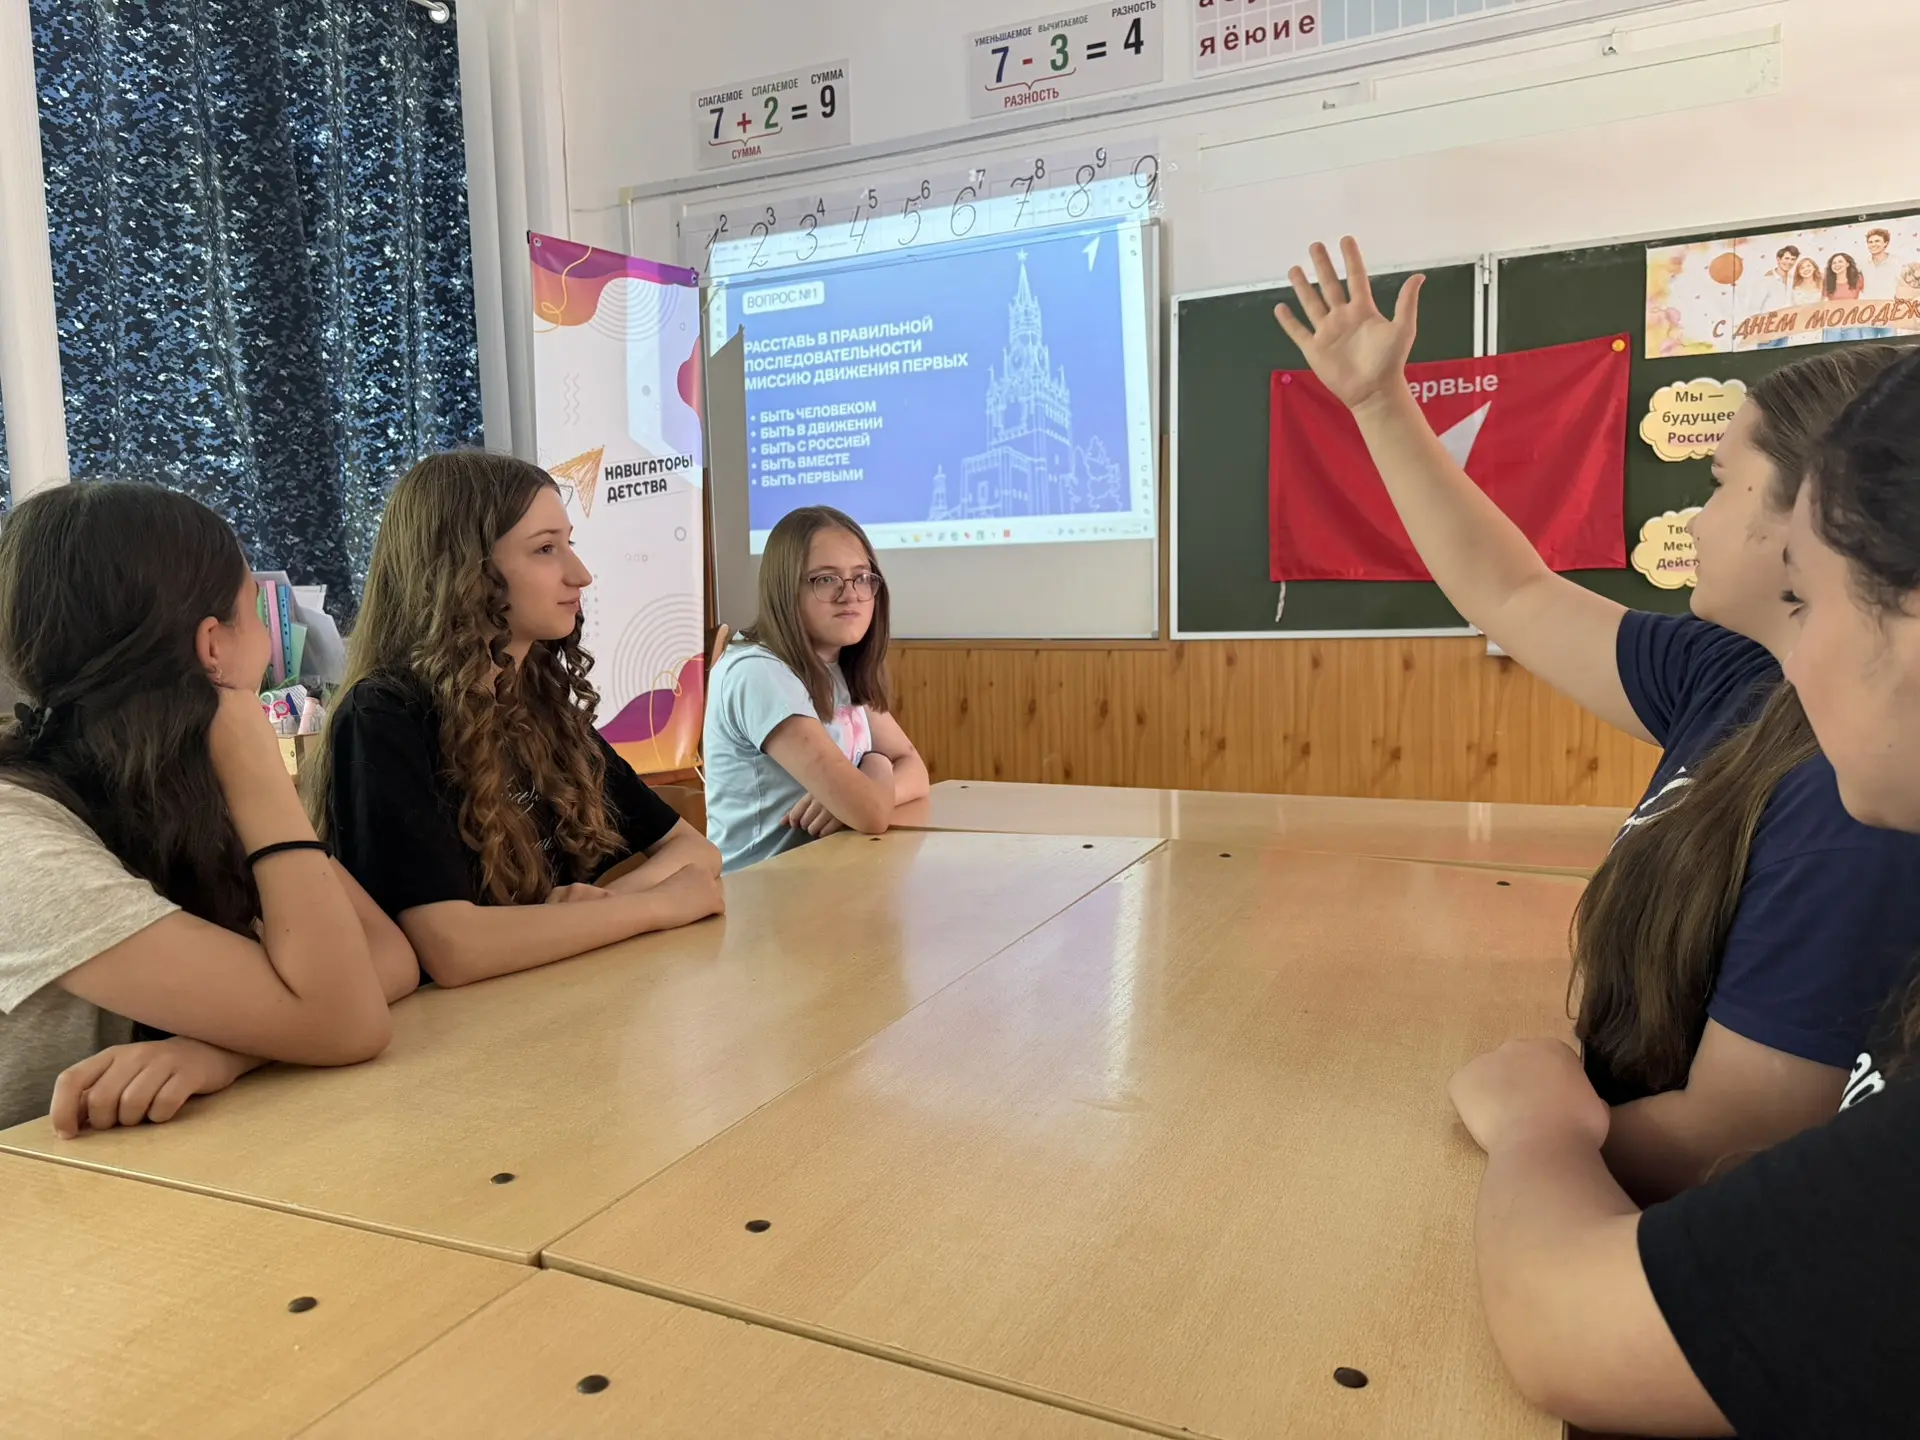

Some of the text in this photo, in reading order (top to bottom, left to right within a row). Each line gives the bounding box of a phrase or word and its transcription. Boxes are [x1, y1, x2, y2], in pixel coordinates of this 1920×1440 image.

[974, 1, 1157, 47] УМЕНЬШАЕМОЕ ВЫЧИТАЕМОЕ РАЗНОСТЬ
[991, 46, 1010, 84] 7
[1050, 33, 1069, 71] 3
[1123, 17, 1144, 56] 4
[698, 68, 844, 108] СЛАГАЕМОЕ СЛАГАЕМОЕ СУММА
[1004, 87, 1060, 109] РАЗНОСТЬ
[709, 106, 724, 139] 7
[763, 96, 779, 130] 2
[820, 84, 836, 119] 9
[731, 145, 762, 160] СУММА
[747, 289, 797, 309] ВОПРОС
[744, 315, 934, 355] РАССТАВЬ В ПРАВИЛЬНОЙ
[1712, 319, 1727, 338] С
[1732, 310, 1799, 341] ДНЁМ
[745, 339, 923, 373] ПОСЛЕДОВАТЕЛЬНОСТИ
[745, 352, 969, 391] МИССИЮ ДВИЖЕНИЯ ПЕРВЫХ
[1675, 391, 1703, 403] Мы
[760, 400, 877, 424] БЫТЬ ЧЕЛОВЕКОМ
[1662, 410, 1735, 427] будущее
[760, 416, 883, 439] БЫТЬ В ДВИЖЕНИИ
[760, 432, 871, 455] БЫТЬ С РОССИЕЙ
[604, 454, 693, 481] НАВИГАТОРЫ
[761, 453, 851, 471] БЫТЬ ВМЕСТЕ
[761, 469, 864, 487] БЫТЬ ПЕРВЫМИ
[606, 478, 668, 503] ДЕТСТВА
